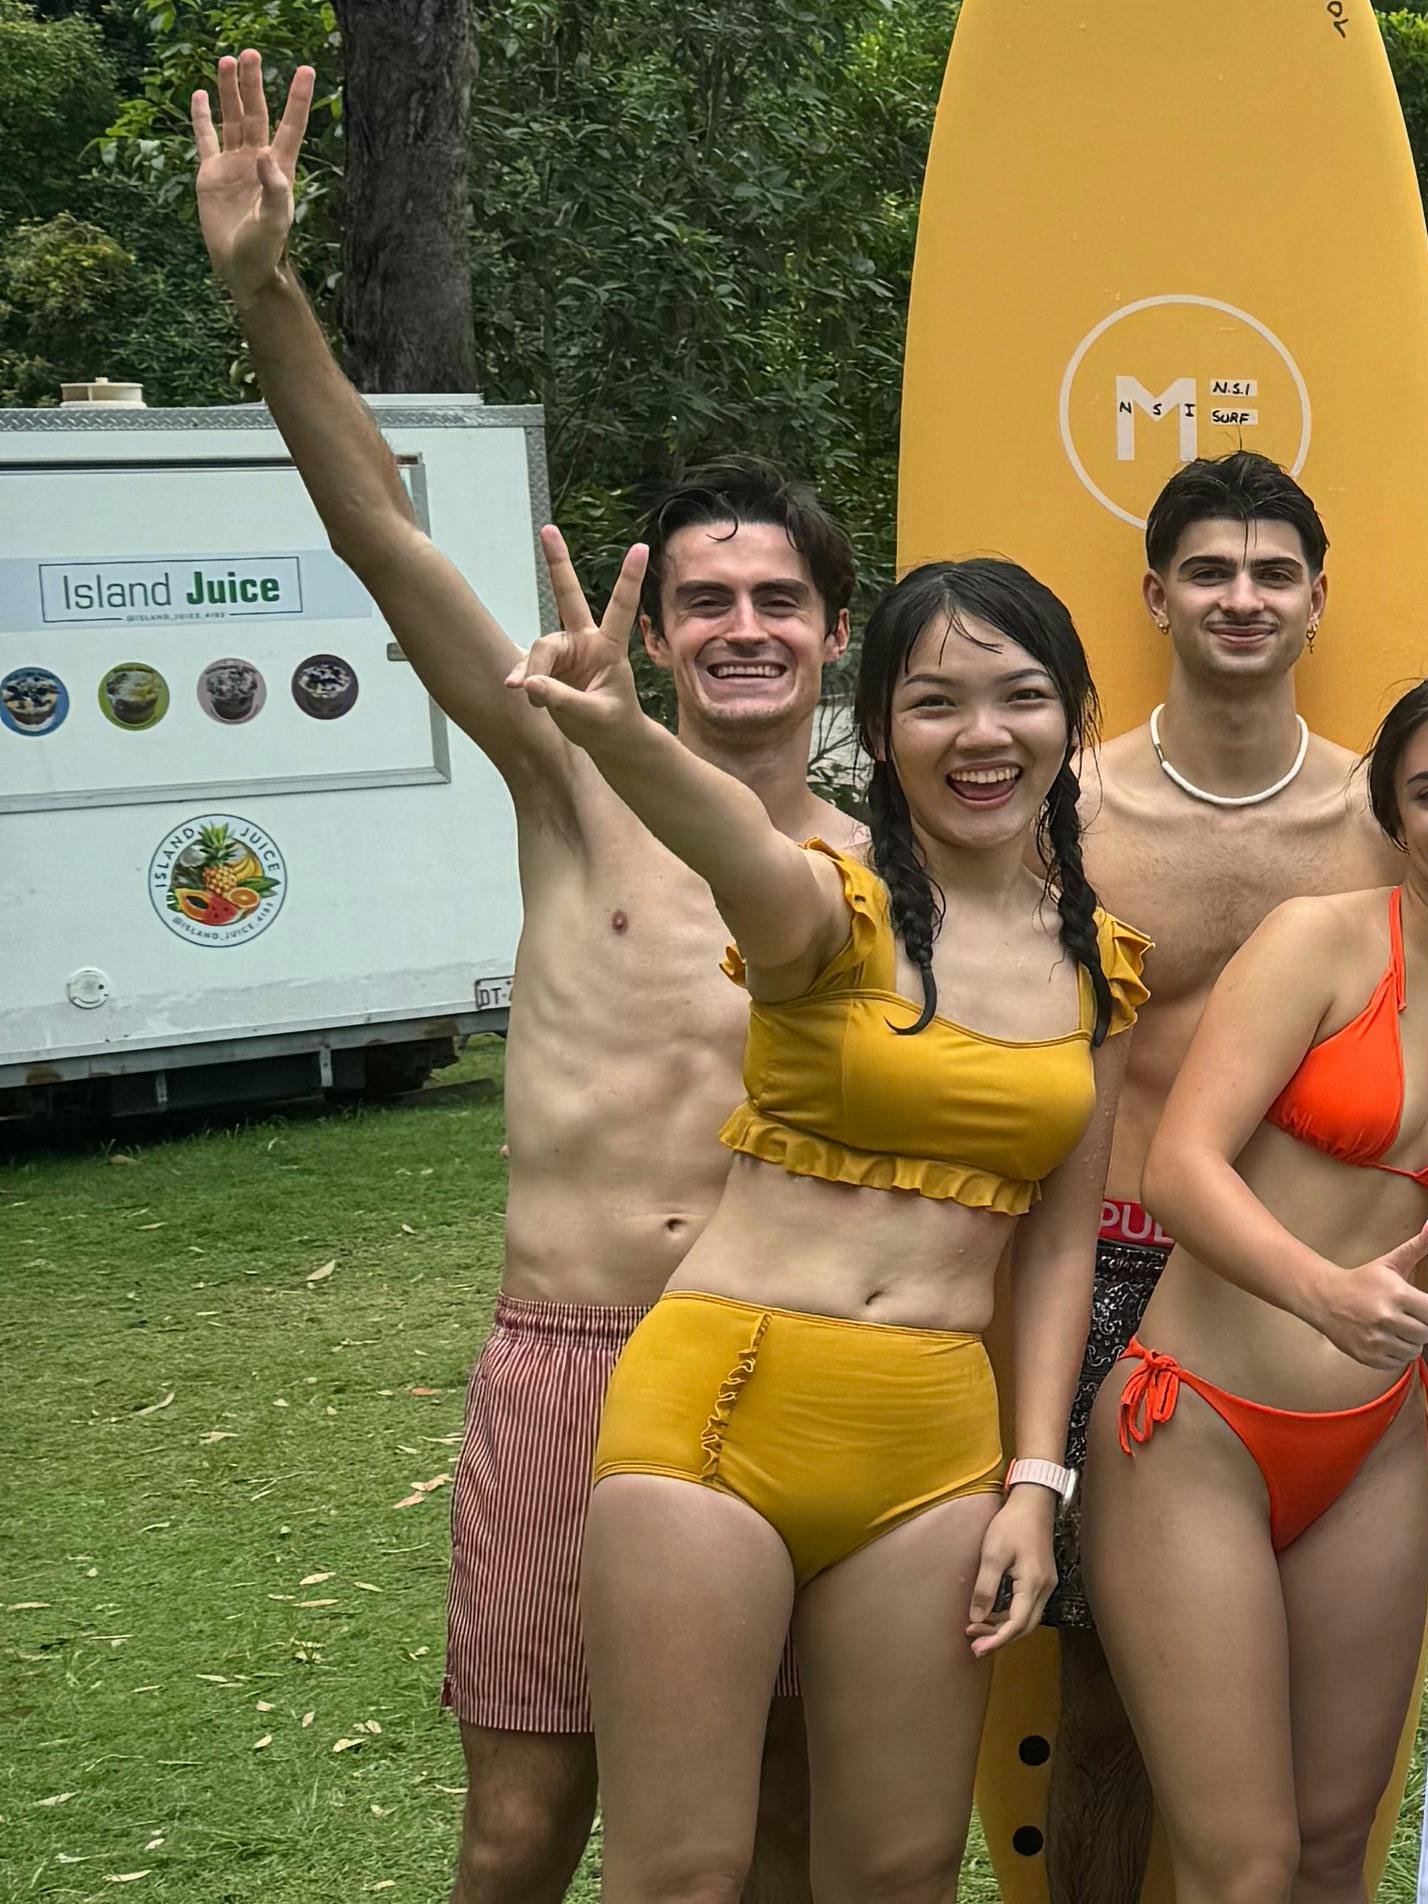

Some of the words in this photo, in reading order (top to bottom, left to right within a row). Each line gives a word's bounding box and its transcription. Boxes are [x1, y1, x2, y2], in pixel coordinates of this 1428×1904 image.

[1211, 410, 1250, 424] SURF
[63, 572, 171, 610] Island
[186, 571, 280, 605] Juice
[155, 827, 195, 888] ISLAND
[240, 827, 280, 872] JUICE
